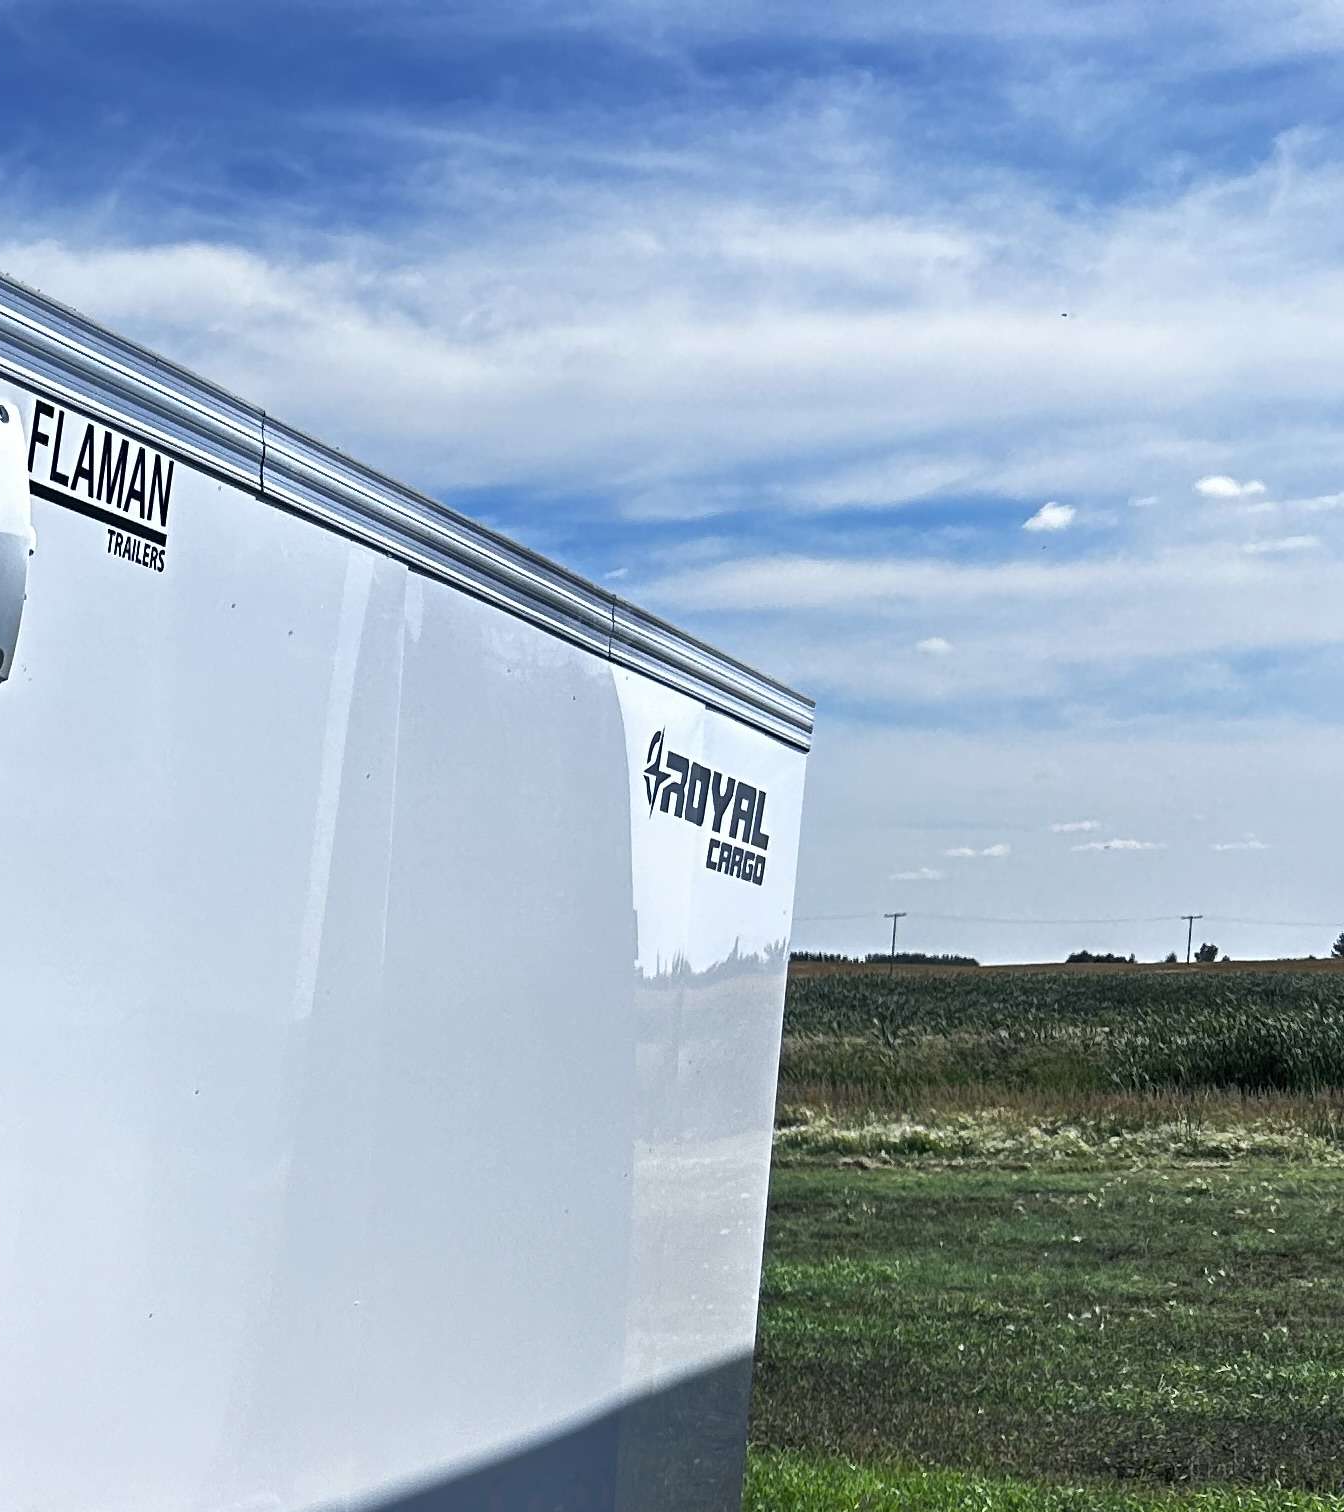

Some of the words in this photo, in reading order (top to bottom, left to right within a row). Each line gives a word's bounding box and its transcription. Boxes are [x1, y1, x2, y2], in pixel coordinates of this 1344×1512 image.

[28, 399, 175, 527] FLAMAN
[107, 528, 166, 573] TRAILERS
[659, 750, 770, 851] ROYAL
[706, 837, 767, 887] CARGO
